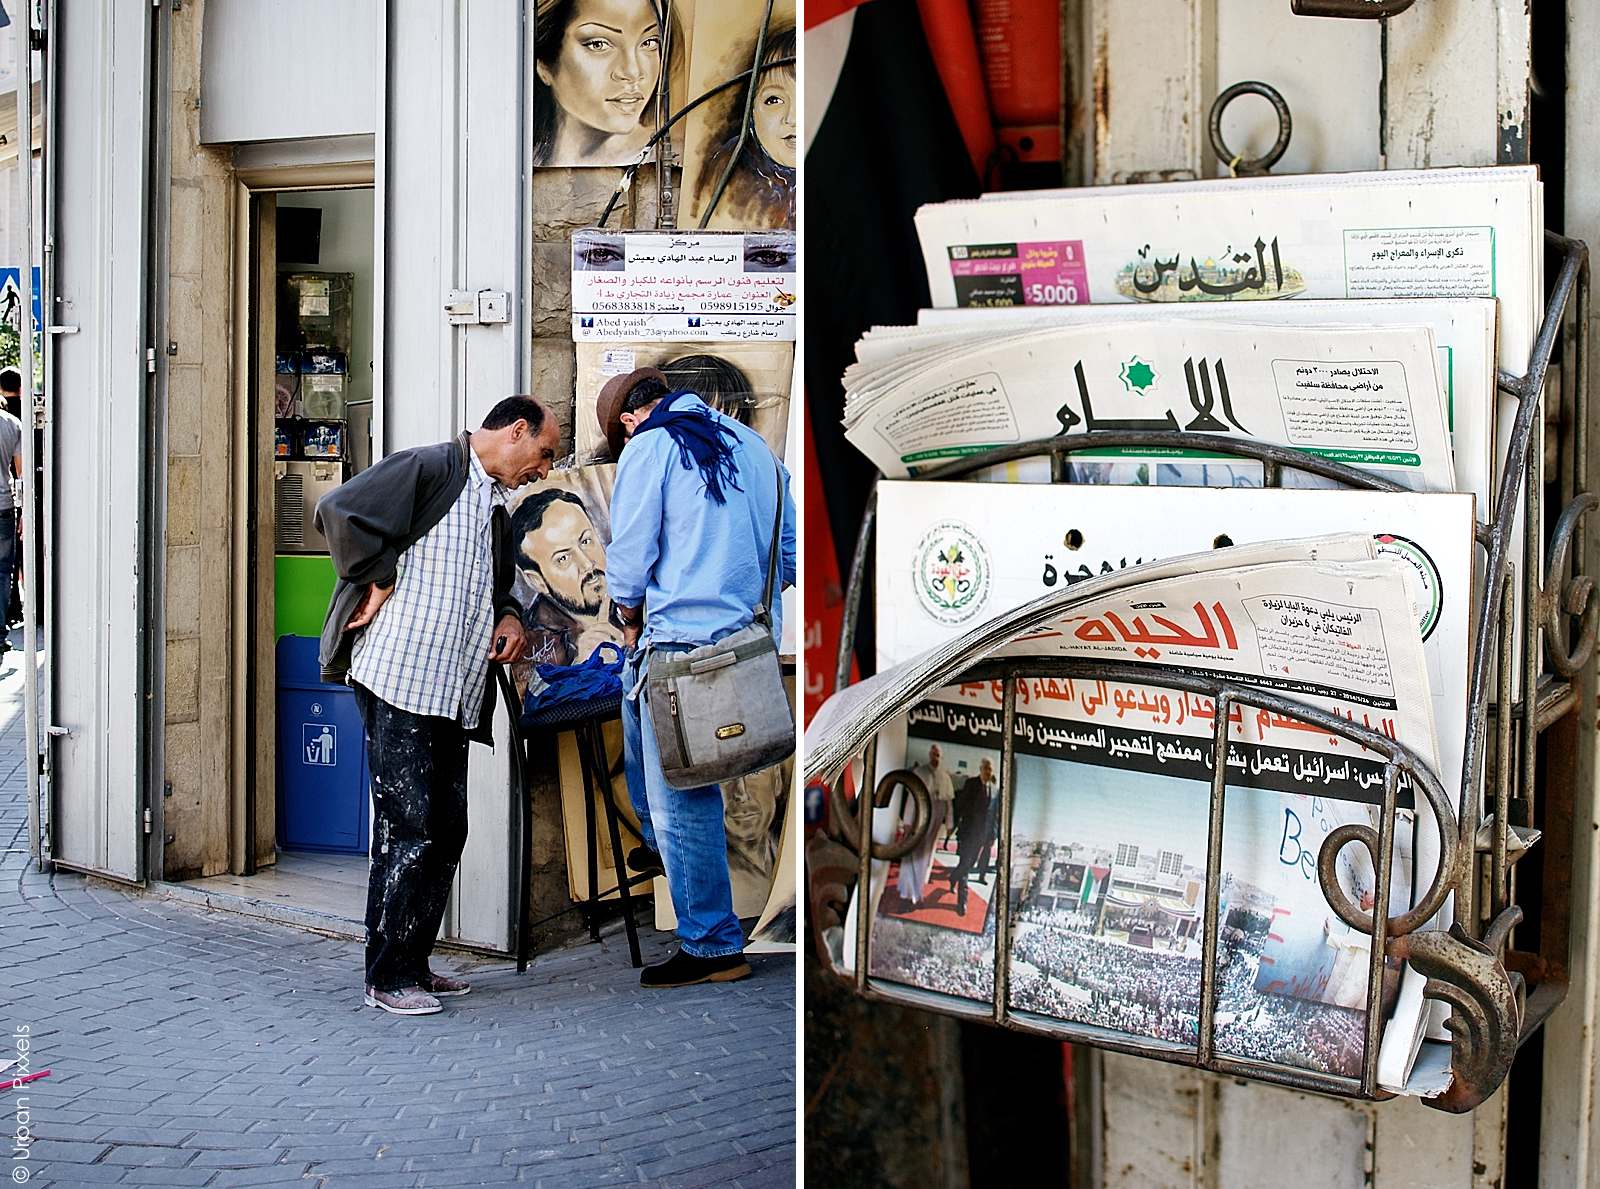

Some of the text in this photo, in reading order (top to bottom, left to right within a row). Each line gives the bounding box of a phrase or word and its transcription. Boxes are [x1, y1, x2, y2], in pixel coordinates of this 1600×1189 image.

[669, 239, 700, 248] مركز
[628, 254, 737, 264] الرسام عبد الهادي يعيش
[1371, 247, 1464, 261] ذكرى الإسراء والمعراج اليوم
[586, 275, 784, 287] لتعليم فنون الرسم بأنواعه للكبار والصغار
[617, 290, 652, 300] التجاري
[654, 291, 675, 299] زيادة
[677, 291, 705, 301] مجمع
[707, 290, 732, 300] عمارة
[742, 291, 771, 300] العنوان
[592, 302, 655, 311] 0568383818
[700, 302, 764, 311] 0598915195
[765, 304, 786, 312] جوال
[596, 318, 620, 327] Abed
[623, 318, 647, 328] yaish
[761, 319, 784, 327] الرسام
[596, 329, 708, 338] Abedyaish_73@yahoo.com
[743, 329, 759, 338] شارع
[761, 329, 778, 337] رسام
[1296, 366, 1313, 375] دونم
[1330, 368, 1351, 377] يصادر
[1352, 368, 1379, 376] الاحتلال
[1296, 381, 1383, 392] من أراضي محافظة سلفيت
[1262, 600, 1362, 624] الرئيس يلبي دعوة البابا لزيارة
[1060, 600, 1239, 660] الحياة
[1281, 615, 1353, 637] الفاتيكان في 6 حزيران
[1269, 663, 1278, 671] 15
[1114, 687, 1169, 725] ويدعو
[907, 704, 945, 726] القدس
[948, 708, 967, 731] من
[969, 711, 1035, 743] واللمين
[1037, 723, 1106, 752] المسيحيين
[1108, 733, 1154, 758] لتهجير
[1157, 738, 1202, 763] ممنهج
[1205, 744, 1248, 774] بشل
[1250, 749, 1290, 775] تعمل
[1293, 755, 1350, 785] اسرائيل
